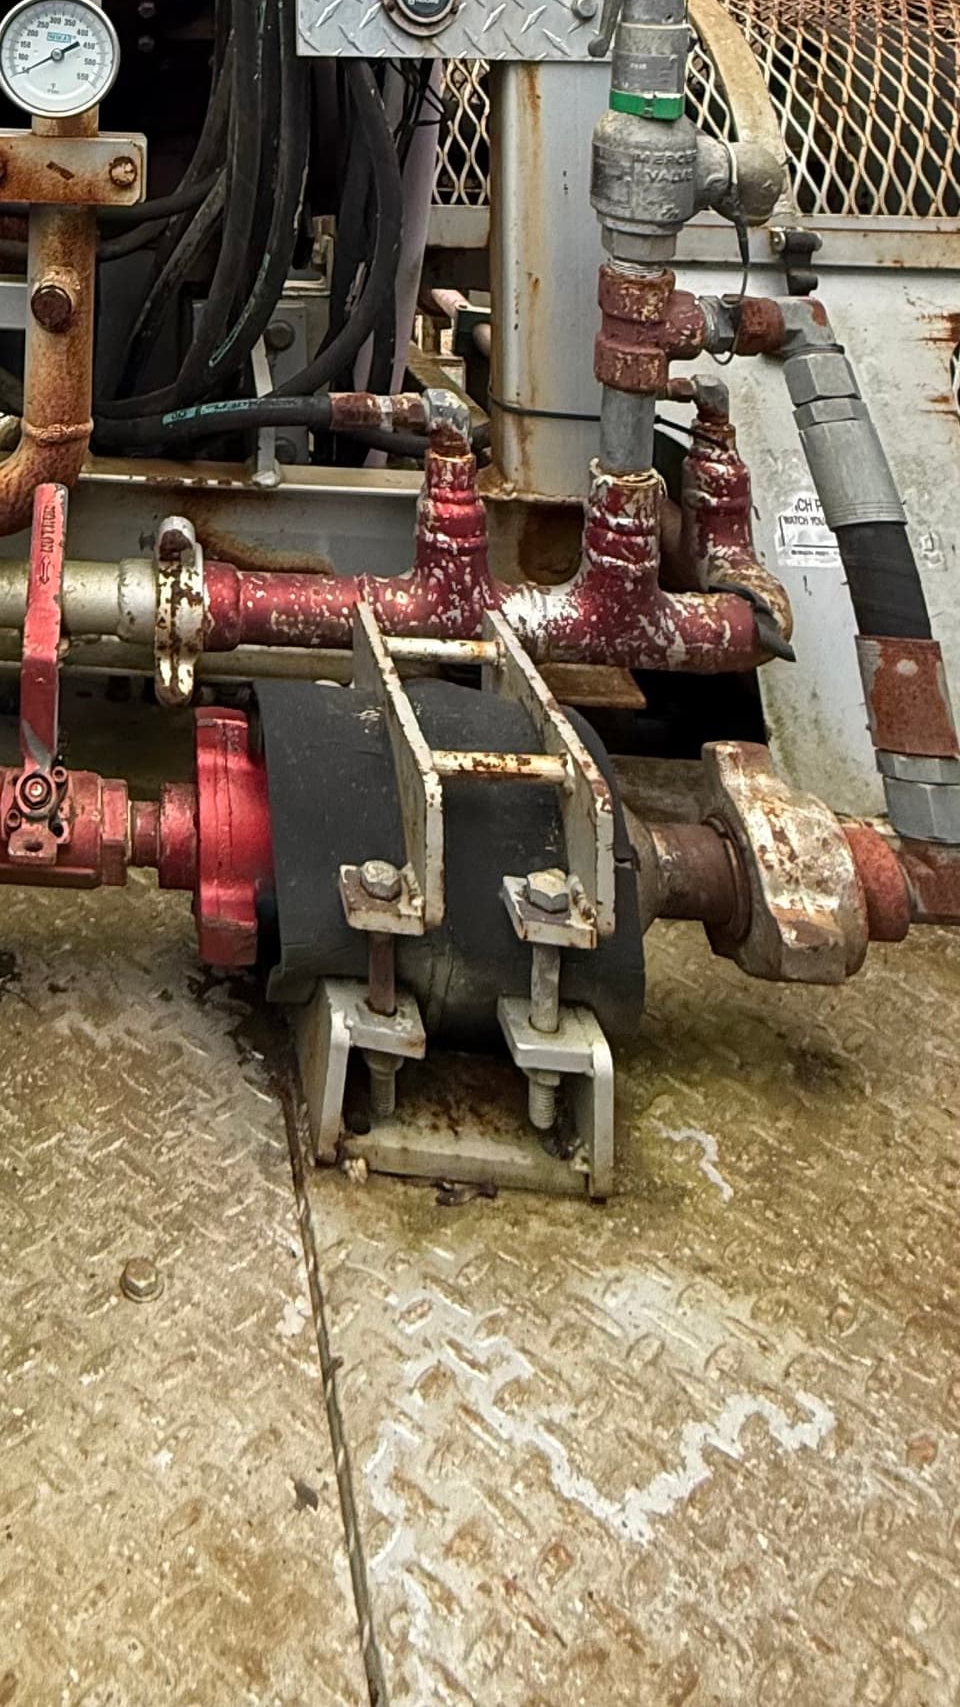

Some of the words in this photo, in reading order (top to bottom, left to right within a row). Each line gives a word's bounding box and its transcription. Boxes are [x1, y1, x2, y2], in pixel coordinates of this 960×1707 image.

[37, 20, 49, 29] 250
[64, 18, 76, 27] 350
[83, 41, 96, 50] 450
